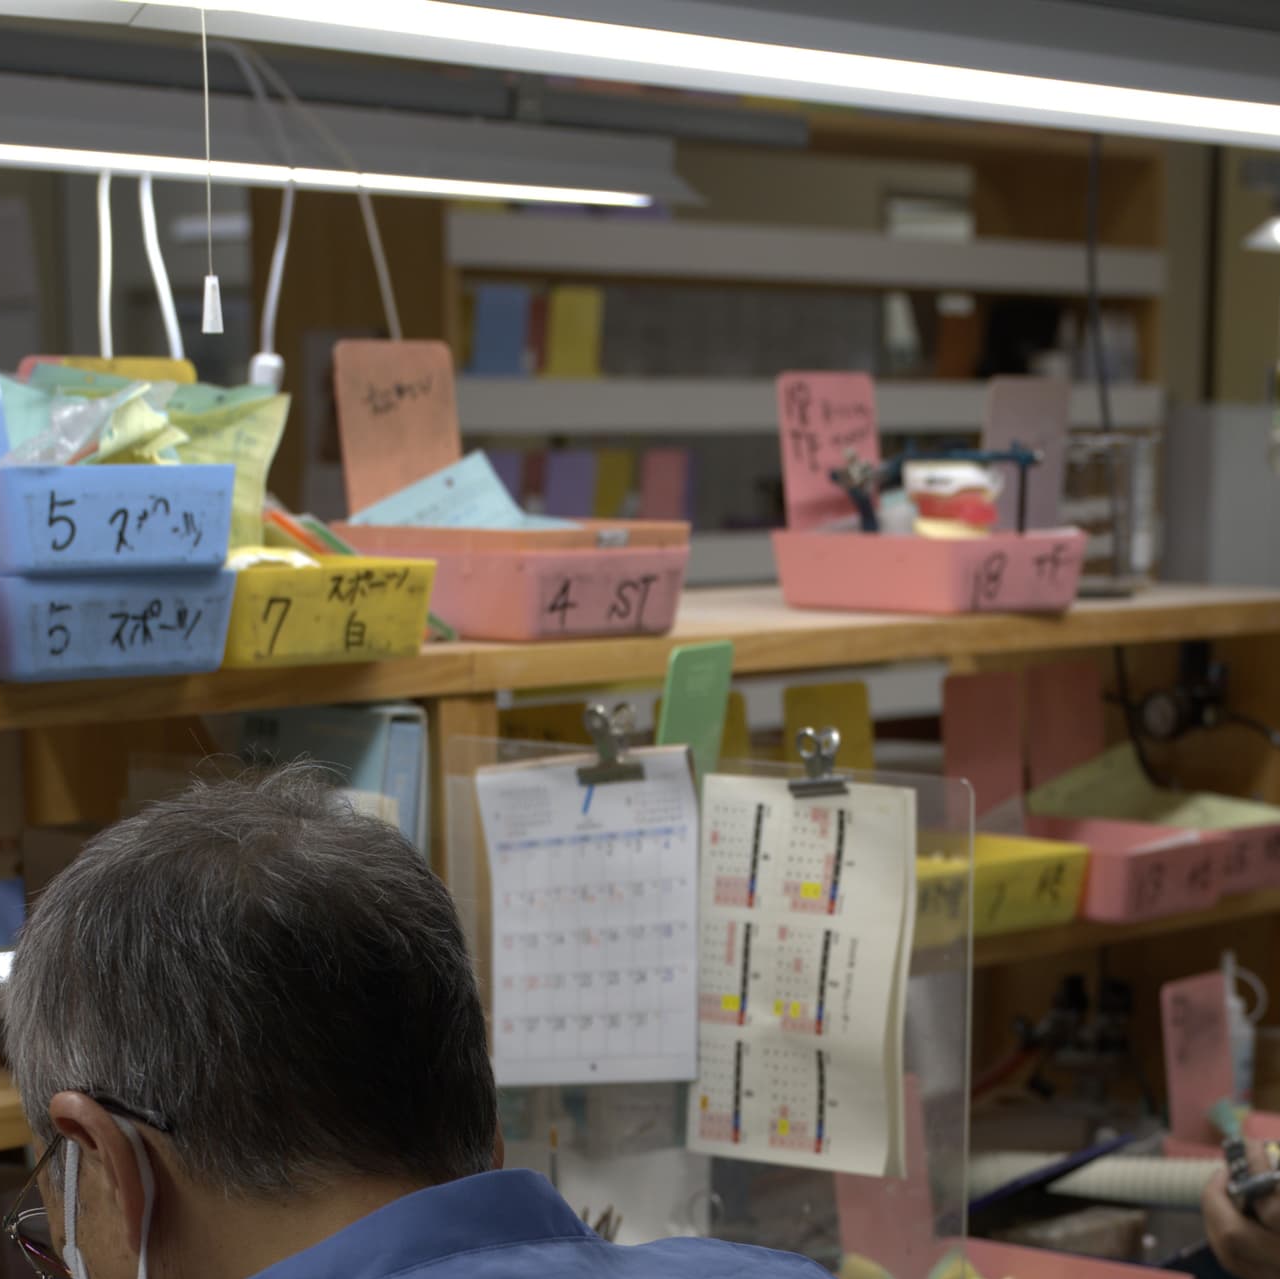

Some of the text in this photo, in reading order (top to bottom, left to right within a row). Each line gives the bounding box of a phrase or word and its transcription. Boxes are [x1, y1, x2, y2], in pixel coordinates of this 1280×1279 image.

[47, 490, 77, 552] 5
[47, 601, 73, 657] 5
[261, 597, 293, 656] 7
[547, 578, 578, 628] 4
